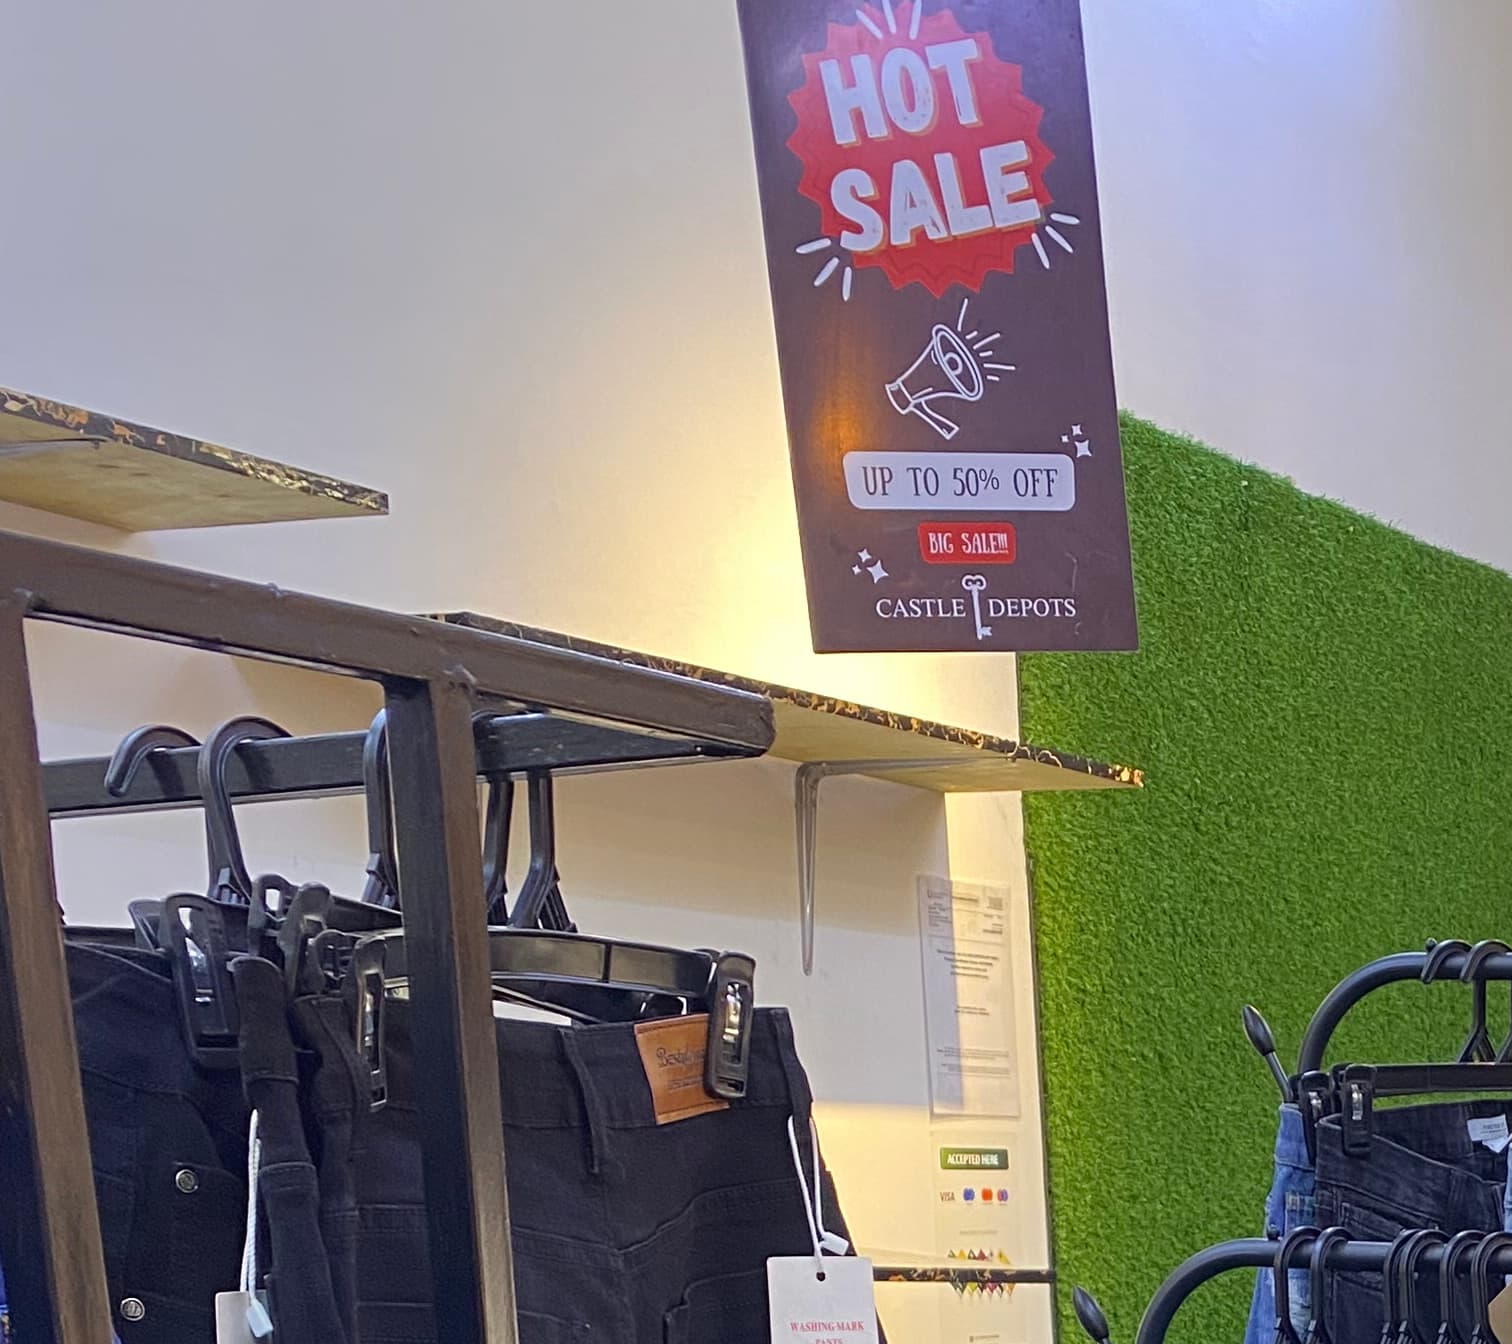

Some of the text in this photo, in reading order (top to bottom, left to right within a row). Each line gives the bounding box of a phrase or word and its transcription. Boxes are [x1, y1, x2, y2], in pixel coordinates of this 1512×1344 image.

[819, 39, 982, 147] HOT
[831, 140, 1042, 252] SALE
[862, 466, 1058, 497] UP TO 50% OFF
[928, 532, 1009, 555] BIG SALE!!!
[876, 598, 1077, 619] CASTLE DEPOTS
[947, 1153, 999, 1165] ACCEPTED HERE
[790, 1320, 865, 1333] WASHING MARK
